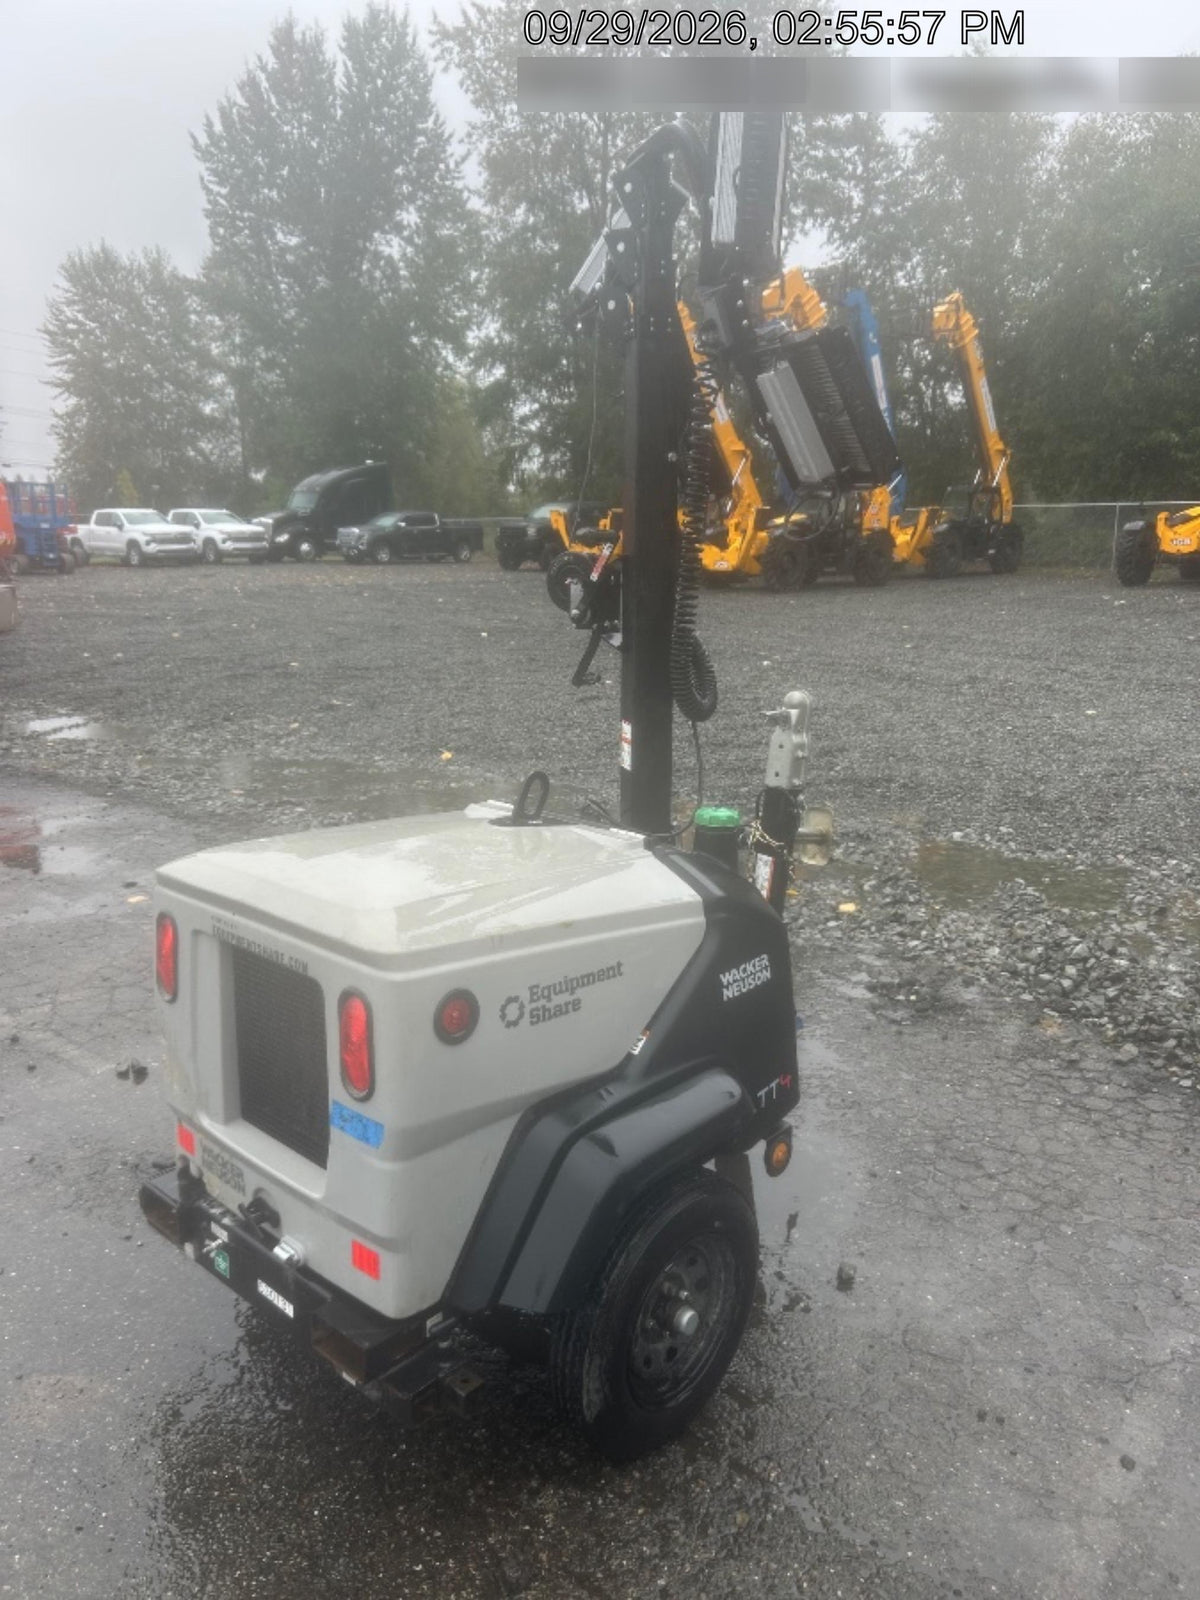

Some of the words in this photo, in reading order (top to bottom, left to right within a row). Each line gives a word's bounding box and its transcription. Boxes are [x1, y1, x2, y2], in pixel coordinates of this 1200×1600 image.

[527, 959, 624, 1004] Equipment
[719, 953, 769, 986] WACKER
[722, 966, 772, 1002] NEUSON
[528, 997, 582, 1026] Share
